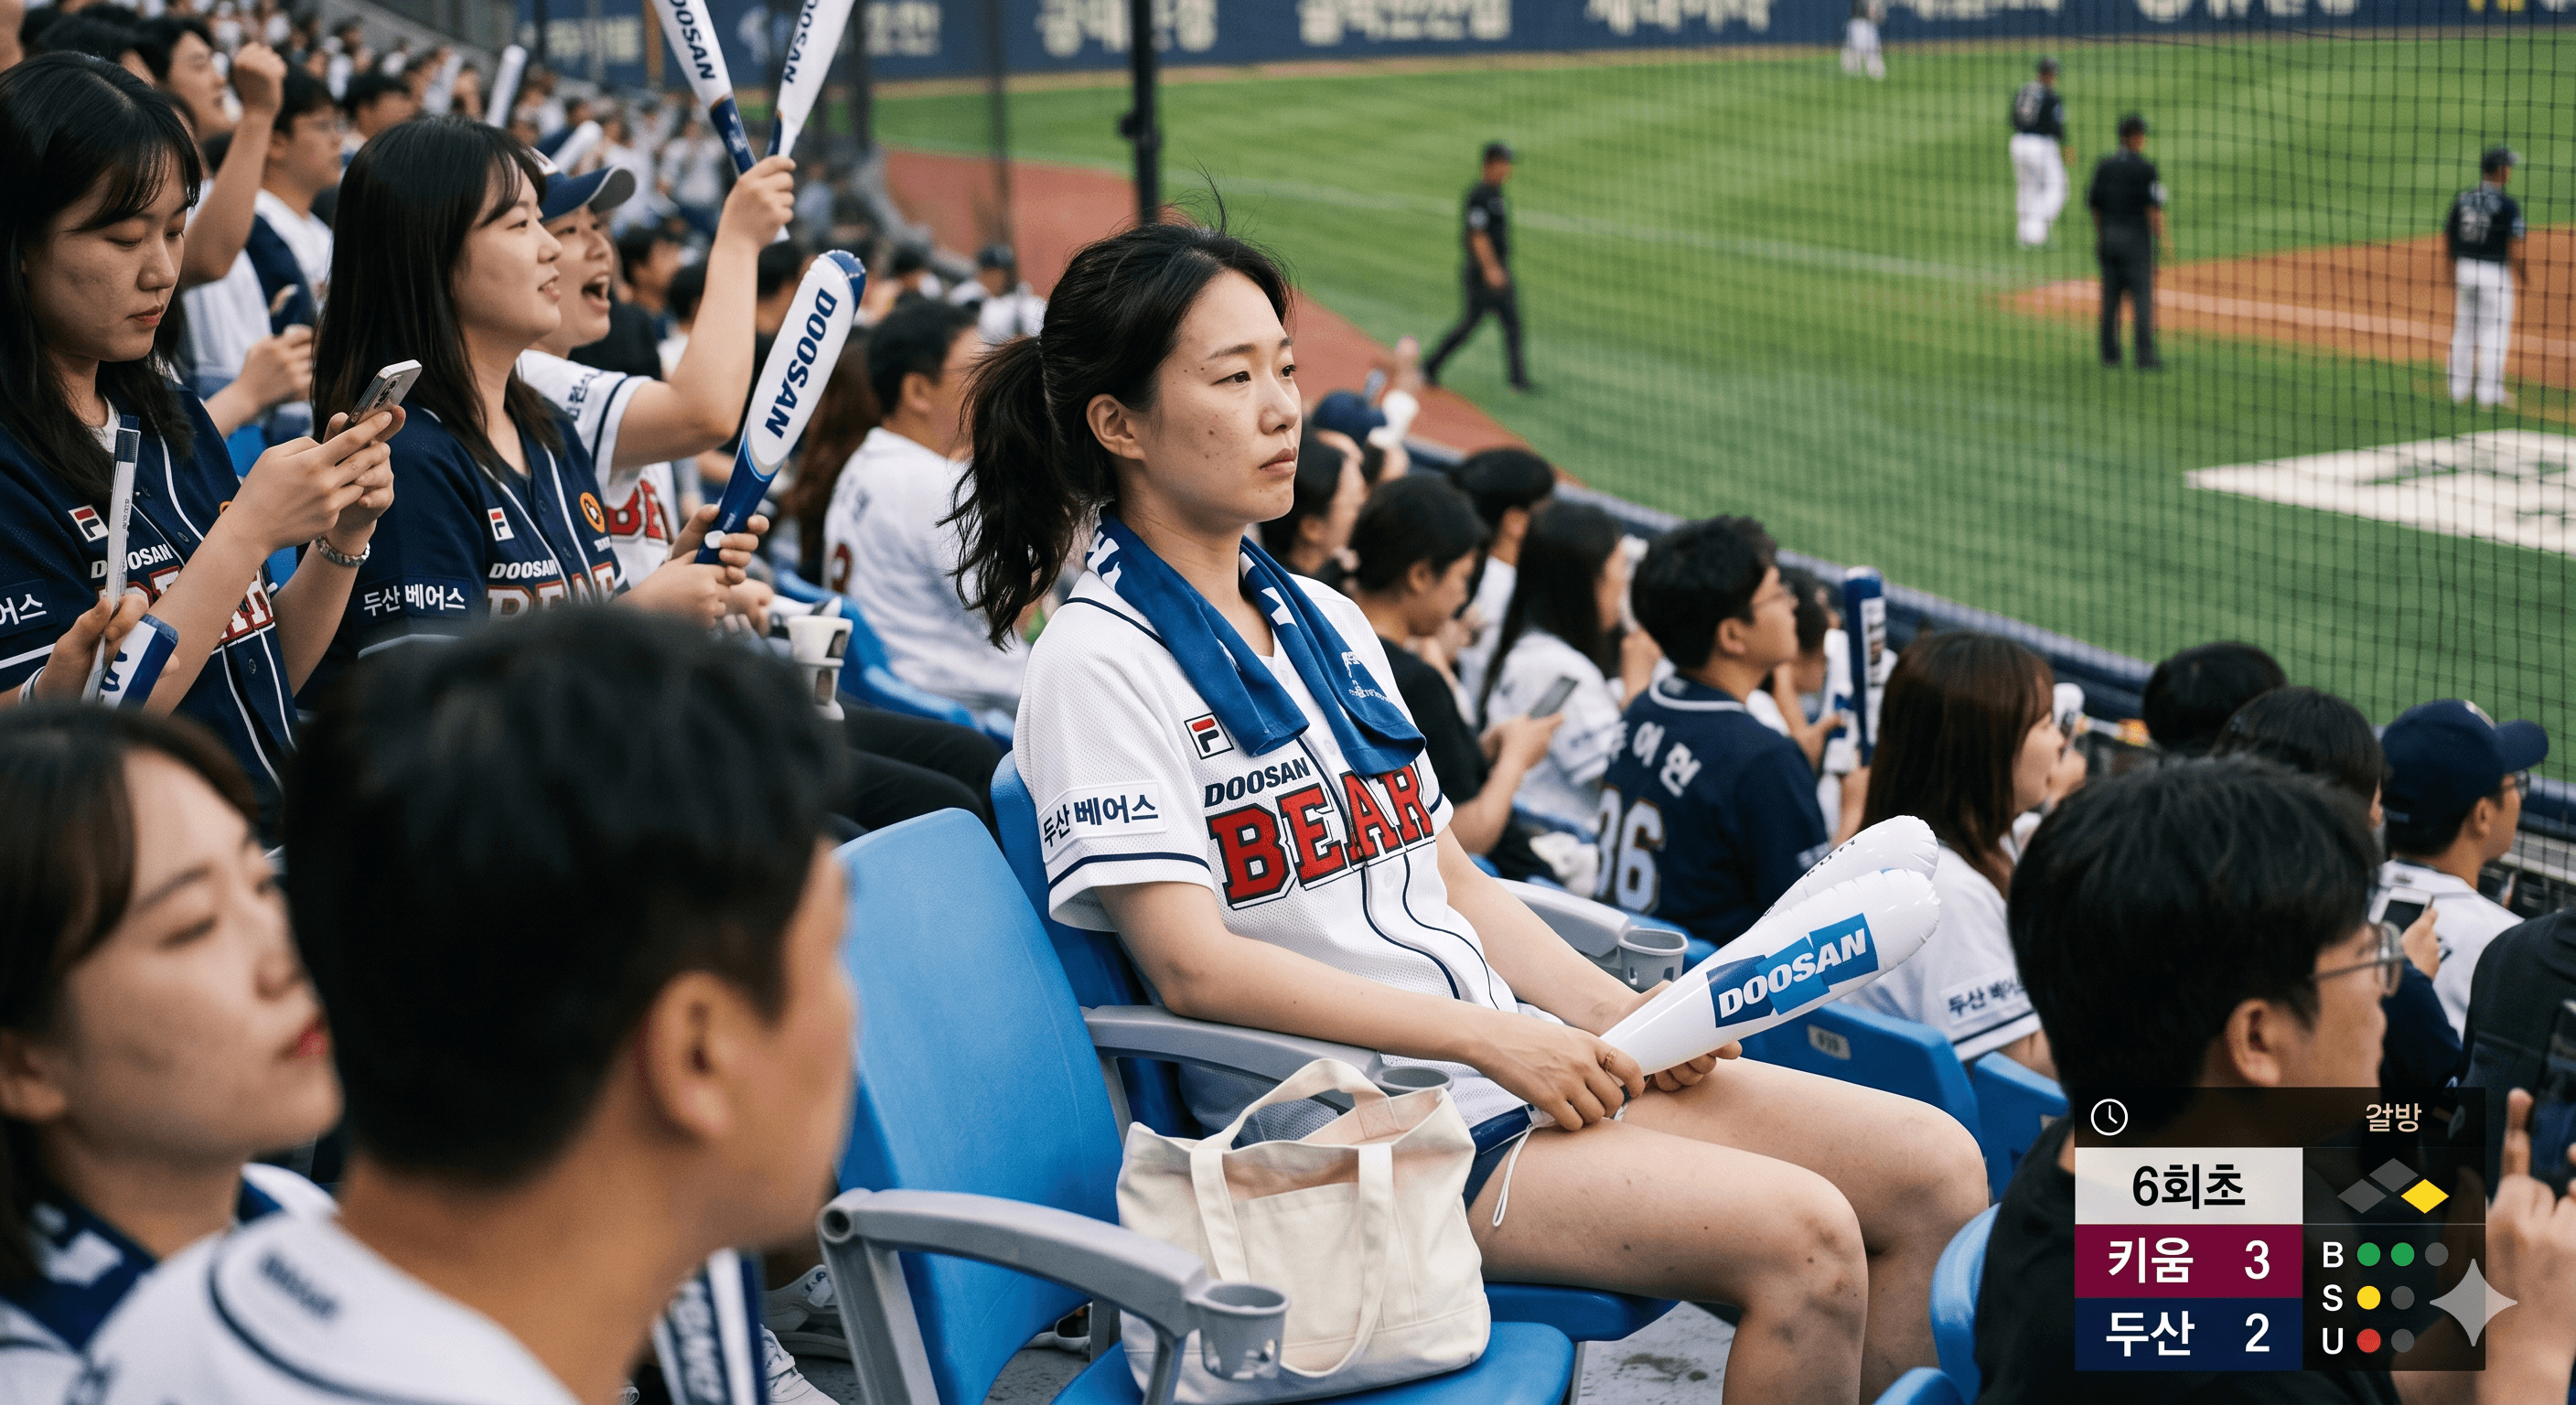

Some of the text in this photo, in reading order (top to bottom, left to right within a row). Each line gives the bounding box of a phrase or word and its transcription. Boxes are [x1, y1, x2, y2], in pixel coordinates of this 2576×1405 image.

[765, 287, 838, 439] DOOSAN
[91, 543, 174, 579] DOSAN
[488, 559, 558, 579] DOOSAN
[363, 584, 466, 617] 두산 베어스
[1204, 756, 1312, 808] DOOSAN
[1043, 794, 1159, 847] 두산 베어스
[1206, 763, 1436, 909] BEAR
[1717, 928, 1868, 1019] DOOSAN
[1948, 986, 1987, 1017] 두산
